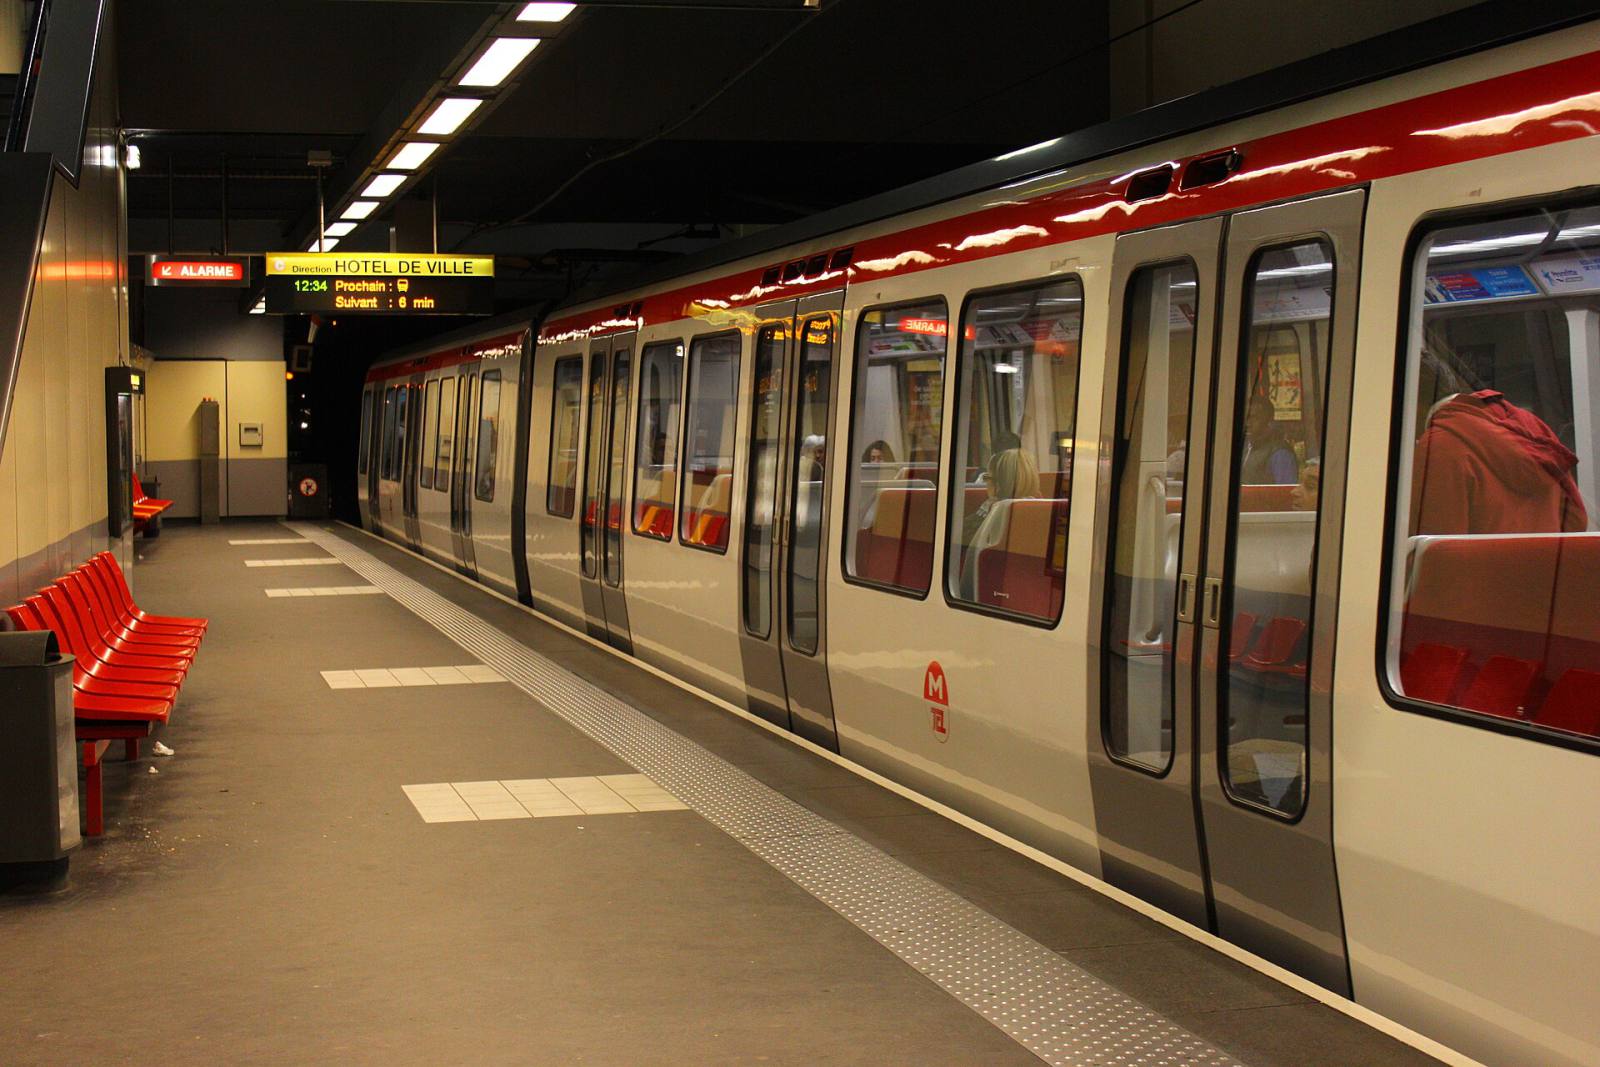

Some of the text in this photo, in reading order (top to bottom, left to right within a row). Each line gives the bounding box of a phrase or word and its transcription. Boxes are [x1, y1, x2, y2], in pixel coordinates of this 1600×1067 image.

[181, 265, 234, 277] ALARME
[292, 260, 473, 274] Direction HOTEL DE VILLE
[294, 280, 328, 292] 12:34
[335, 280, 386, 292] Prochain
[335, 295, 378, 309] Suivant
[413, 296, 435, 309] min
[928, 671, 944, 700] M
